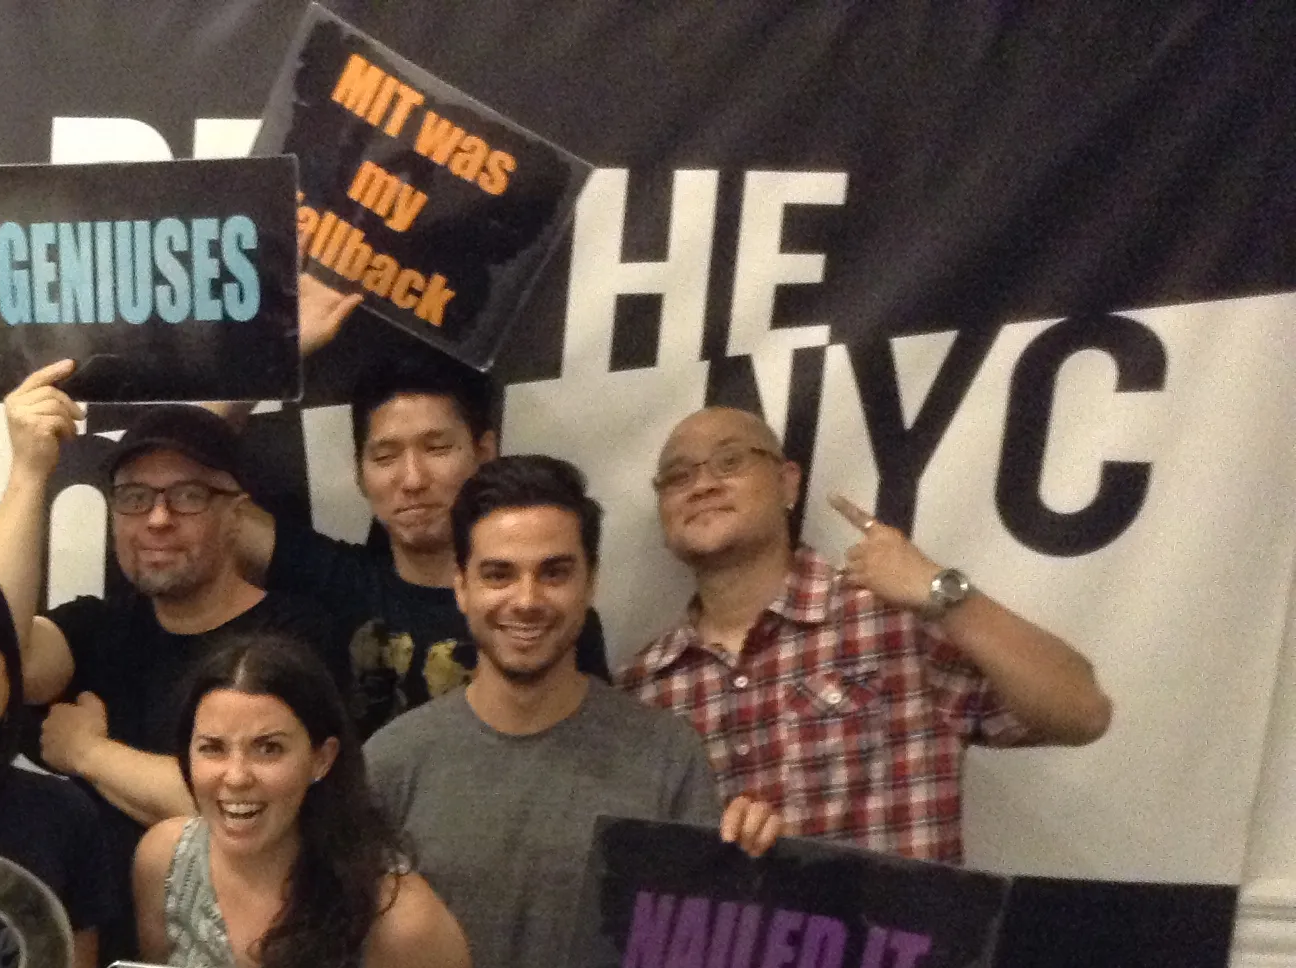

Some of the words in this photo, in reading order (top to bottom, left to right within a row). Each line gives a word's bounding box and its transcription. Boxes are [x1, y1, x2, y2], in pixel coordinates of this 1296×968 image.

[331, 53, 425, 138] MIT
[414, 110, 518, 197] was
[297, 190, 455, 327] allback
[347, 160, 428, 232] my
[559, 168, 848, 379] HE
